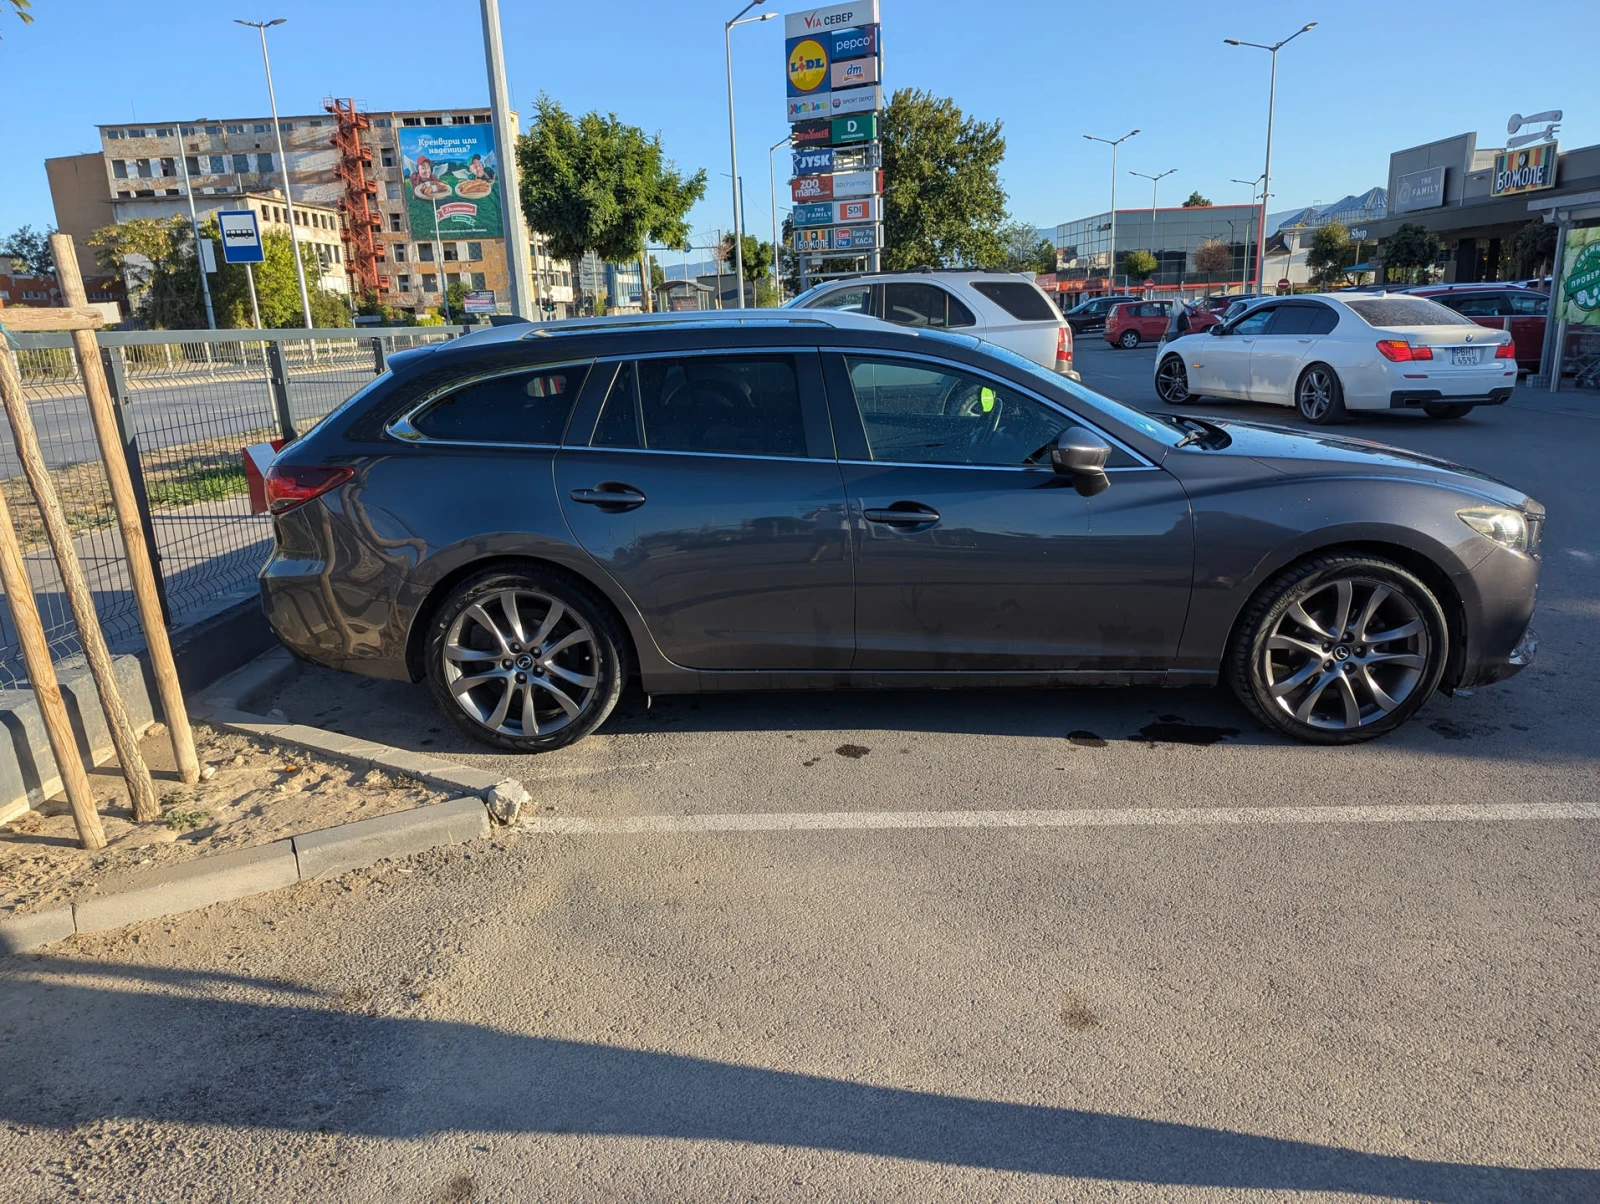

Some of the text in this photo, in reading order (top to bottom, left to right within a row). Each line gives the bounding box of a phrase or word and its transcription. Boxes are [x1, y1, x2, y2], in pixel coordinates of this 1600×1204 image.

[836, 37, 871, 52] pepco
[846, 64, 862, 76] dm
[847, 120, 857, 132] D
[800, 154, 830, 168] JYSK
[1421, 176, 1432, 184] THE
[1496, 165, 1544, 191] БОЖОЛЕ
[1412, 184, 1439, 197] FAMILY
[848, 204, 862, 214] SDI
[1351, 228, 1367, 240] Shop
[798, 239, 830, 249] БОЖОЛЕ
